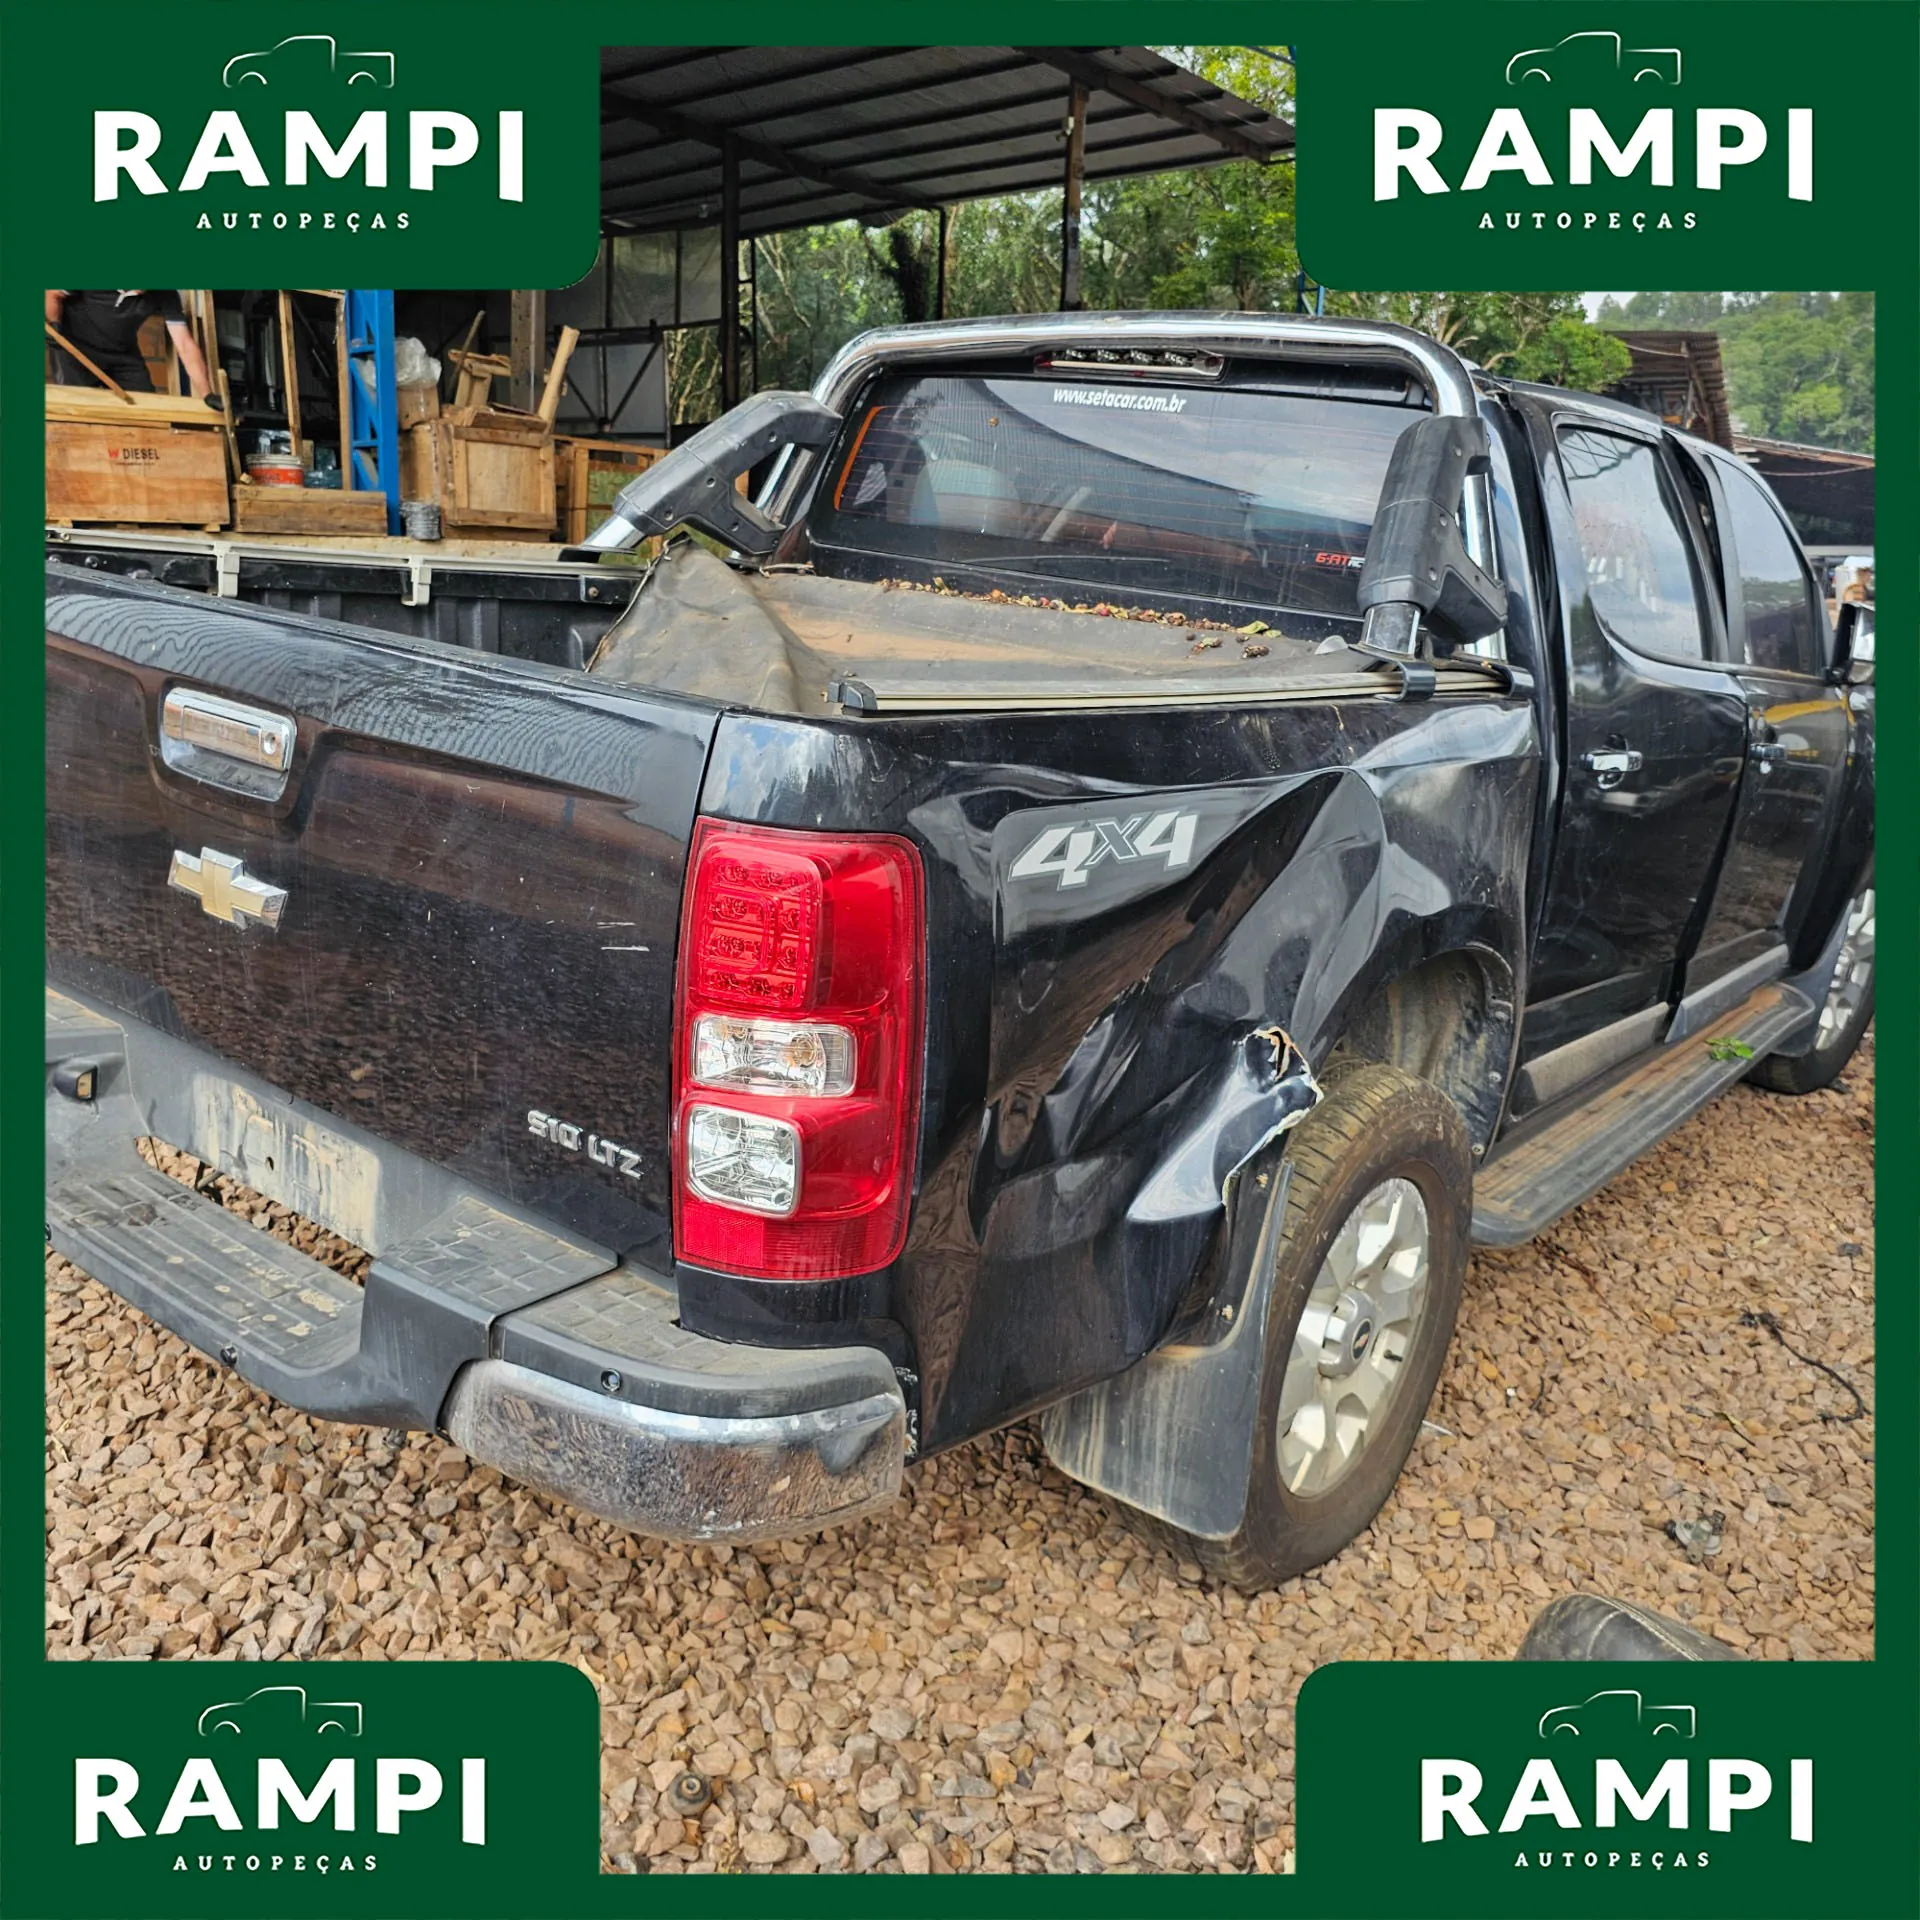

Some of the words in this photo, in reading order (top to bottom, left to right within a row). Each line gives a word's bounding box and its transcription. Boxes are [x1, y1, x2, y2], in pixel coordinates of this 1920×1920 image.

[122, 447, 160, 460] DIESEL
[527, 1109, 583, 1151] S10
[587, 1134, 644, 1180] LTZ
